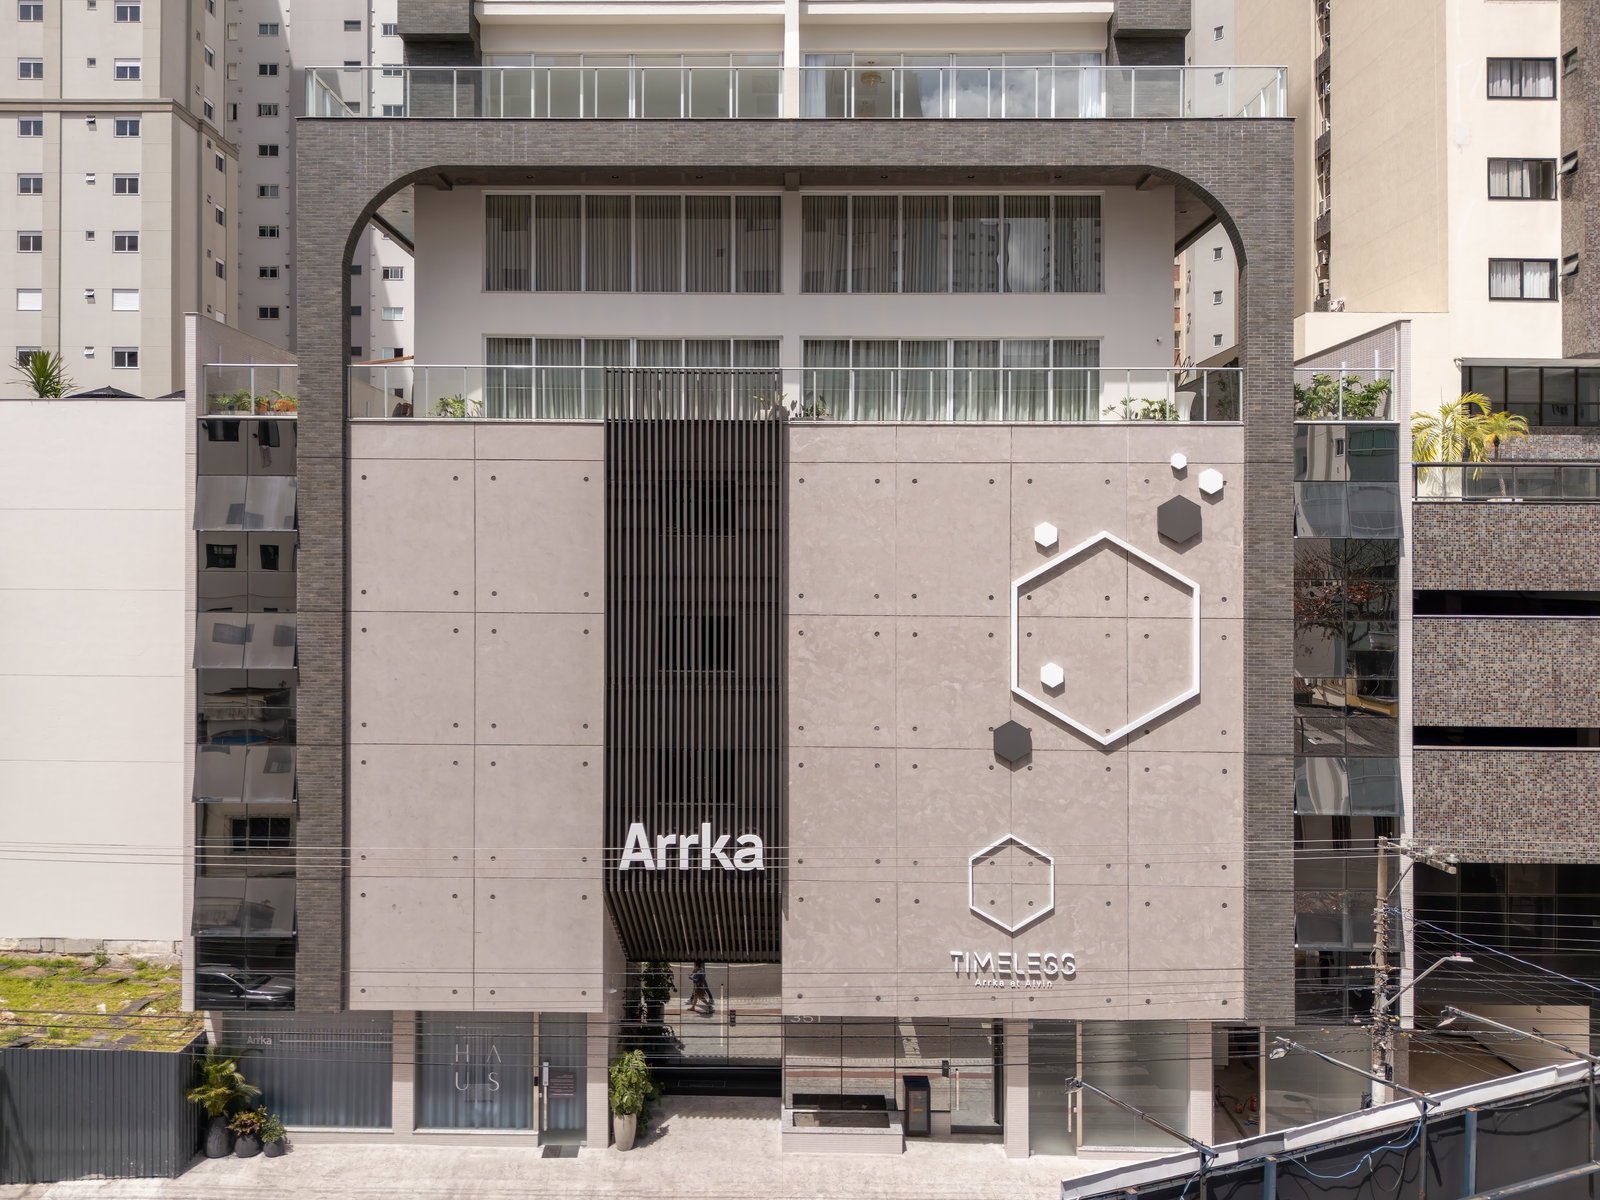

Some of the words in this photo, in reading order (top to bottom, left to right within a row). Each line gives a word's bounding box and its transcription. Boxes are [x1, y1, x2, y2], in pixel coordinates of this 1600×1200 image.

[619, 823, 764, 871] Arrka
[950, 951, 1076, 974] TIMELESS
[975, 979, 1004, 987] Arrka
[1025, 979, 1053, 988] Alvin
[247, 1035, 272, 1045] Arrka
